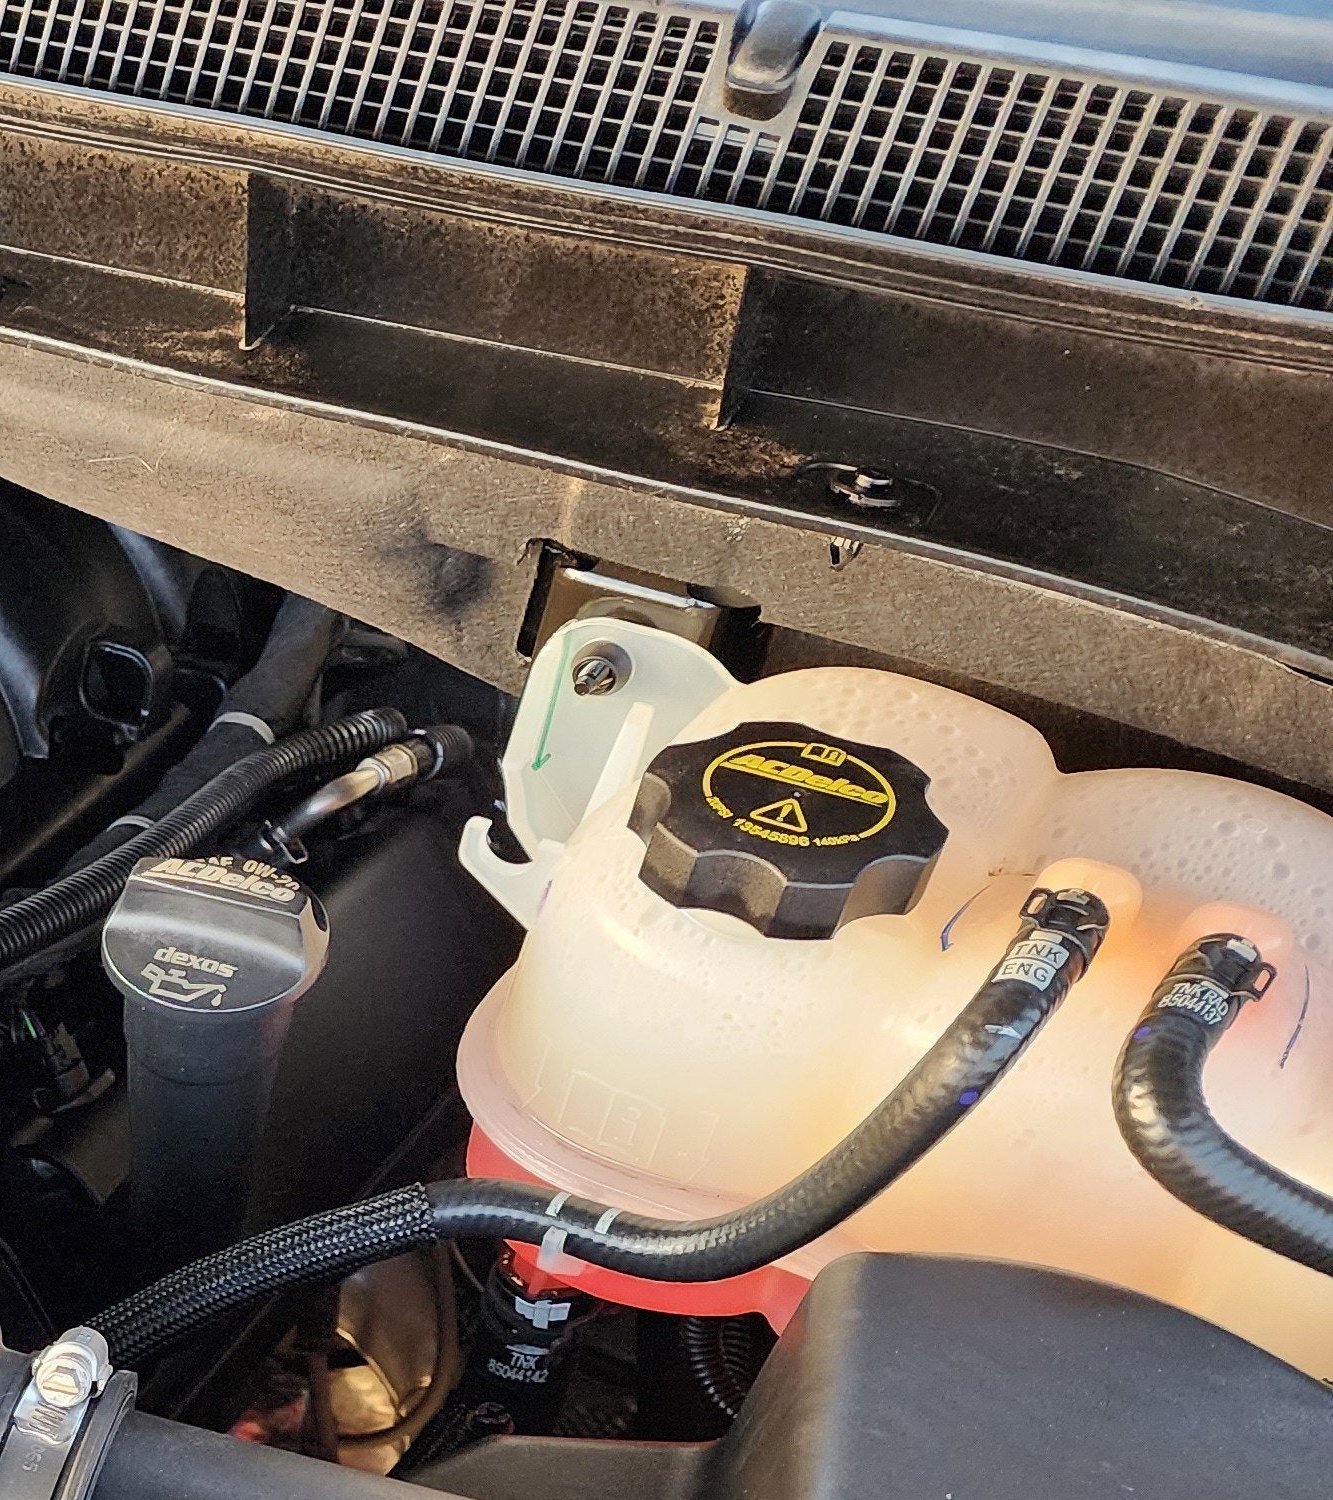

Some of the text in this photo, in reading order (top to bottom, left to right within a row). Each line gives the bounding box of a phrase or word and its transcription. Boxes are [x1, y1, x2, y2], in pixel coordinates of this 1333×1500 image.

[729, 754, 889, 805] ACDelco
[151, 858, 297, 902] ACDelco
[152, 946, 239, 978] dexos
[1014, 943, 1062, 964] TNK
[1001, 962, 1049, 983] ENG
[1156, 993, 1223, 1025] 85044137
[1170, 982, 1230, 1017] TNK RAD
[510, 1351, 541, 1370] TNK
